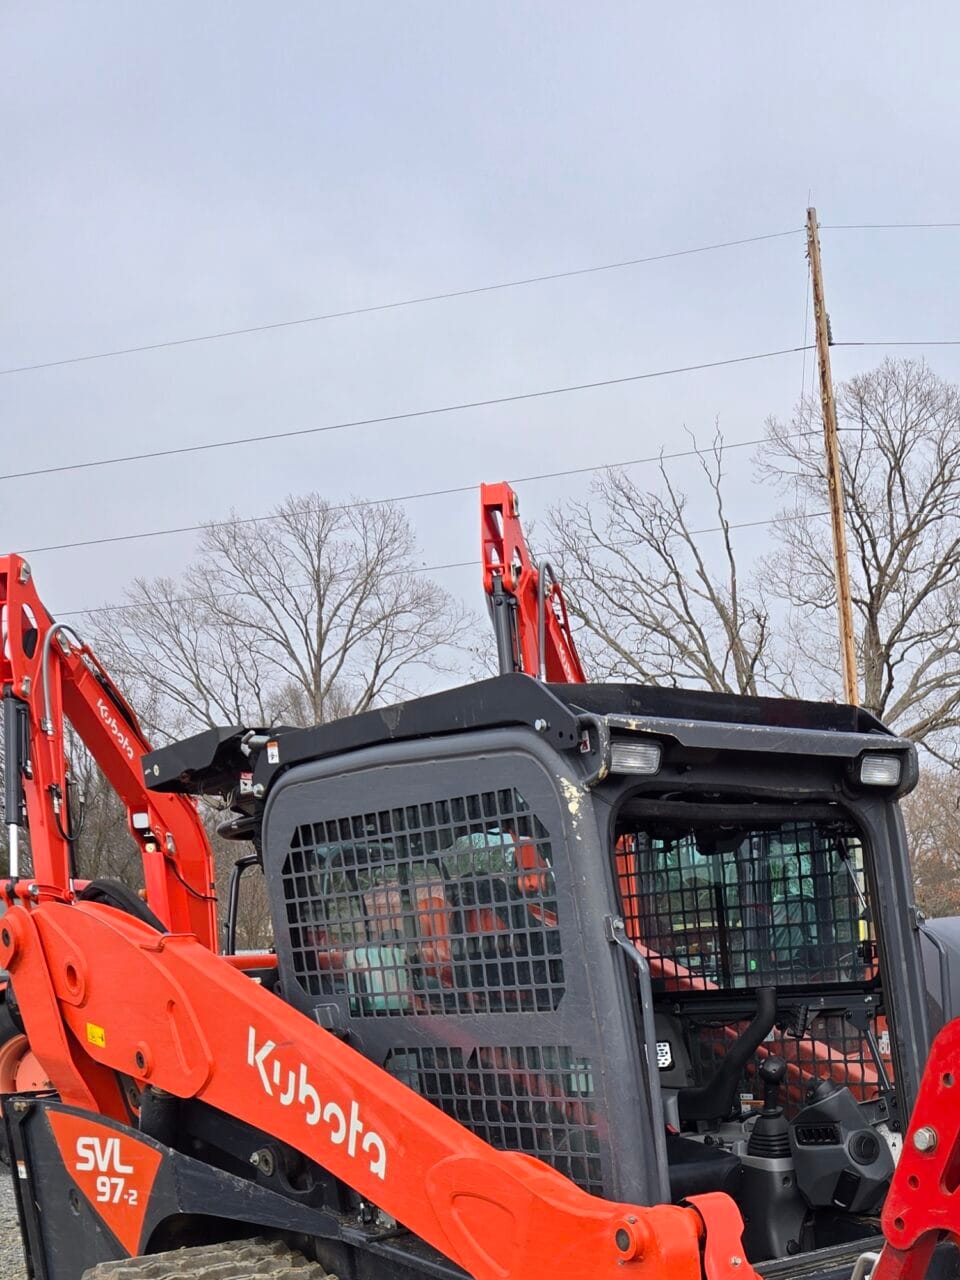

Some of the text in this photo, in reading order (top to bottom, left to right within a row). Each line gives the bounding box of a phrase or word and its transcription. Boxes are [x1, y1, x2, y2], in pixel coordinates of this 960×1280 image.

[96, 698, 134, 760] Kubota
[247, 1025, 387, 1181] Kubota
[76, 1137, 134, 1174] SVL
[96, 1176, 138, 1206] 97-2
